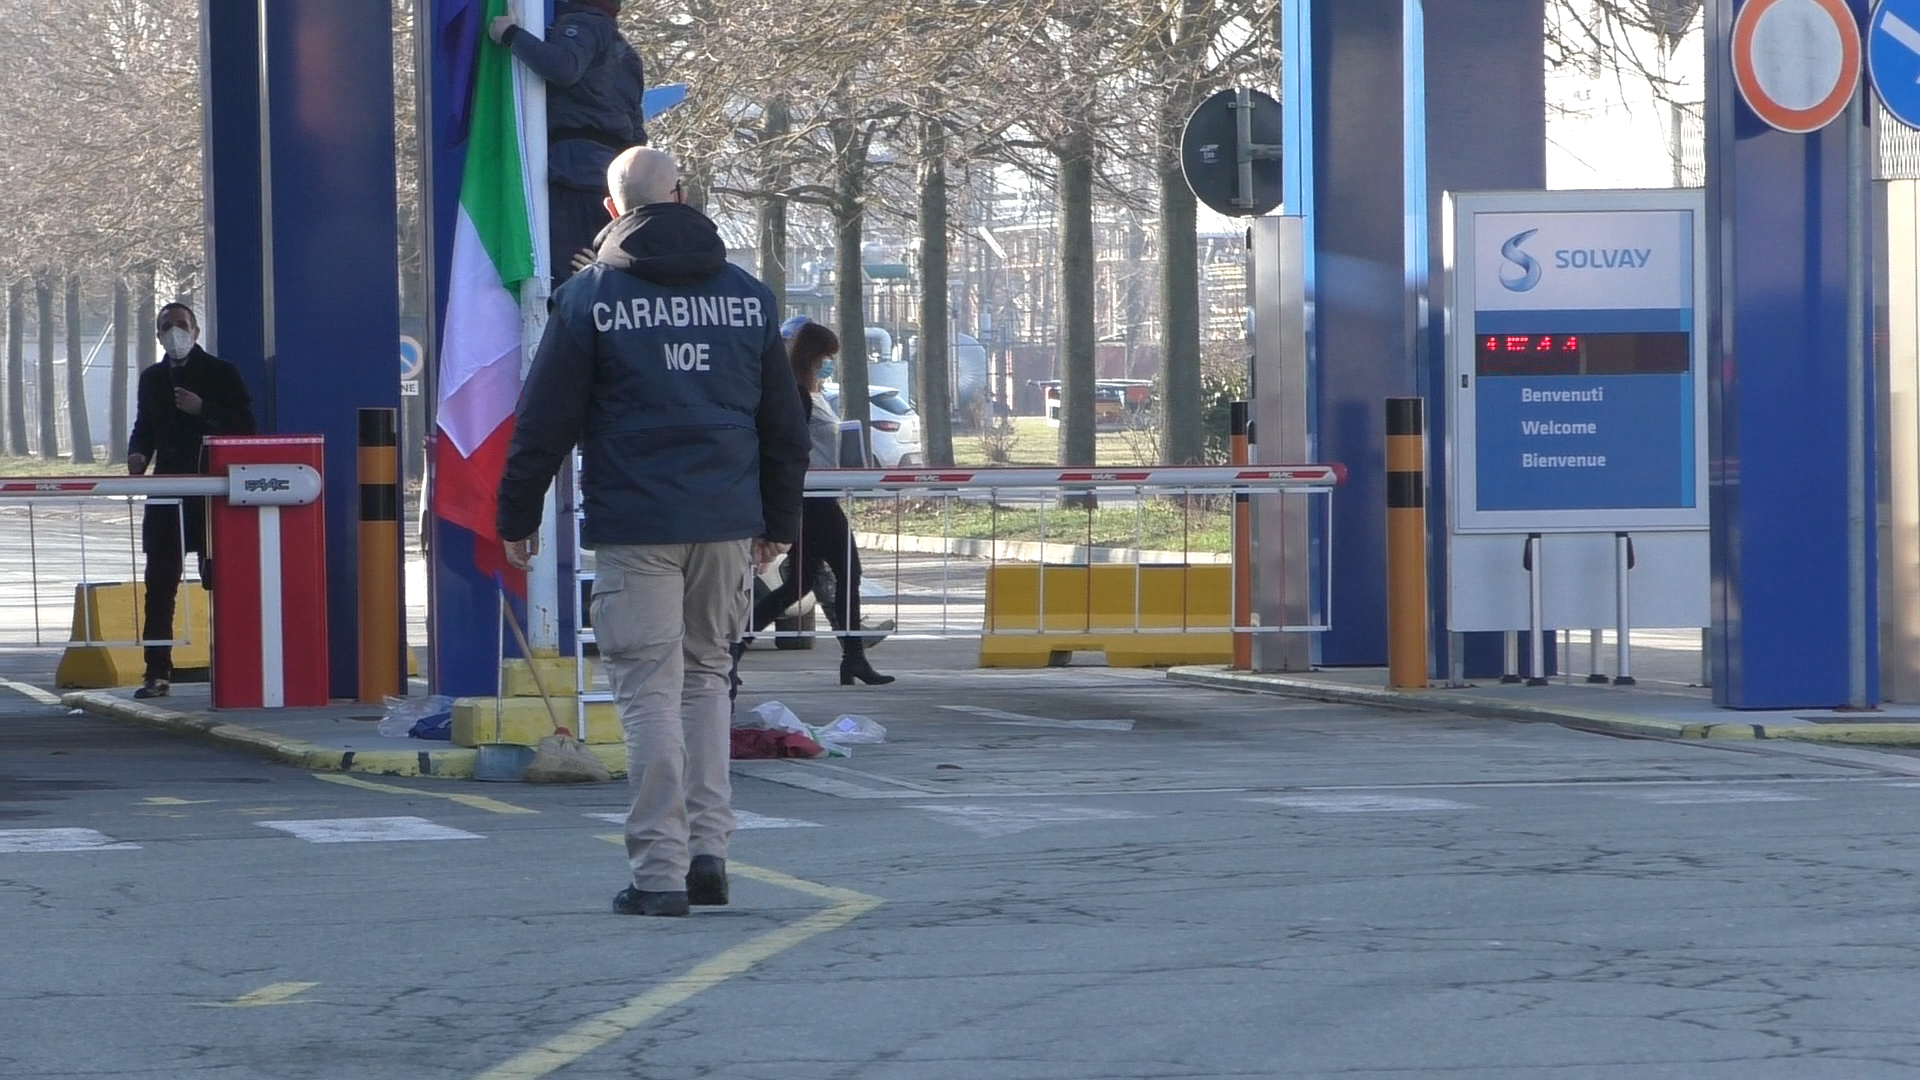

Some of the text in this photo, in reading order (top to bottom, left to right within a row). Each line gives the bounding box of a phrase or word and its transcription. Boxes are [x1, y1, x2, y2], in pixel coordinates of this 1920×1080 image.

[1555, 249, 1652, 269] SOLVAY
[592, 296, 767, 332] CARABINIER
[664, 342, 710, 371] NOE
[1521, 387, 1603, 402] Benvenuti
[1521, 420, 1597, 435] Welcome
[1522, 453, 1606, 468] Bienvenue
